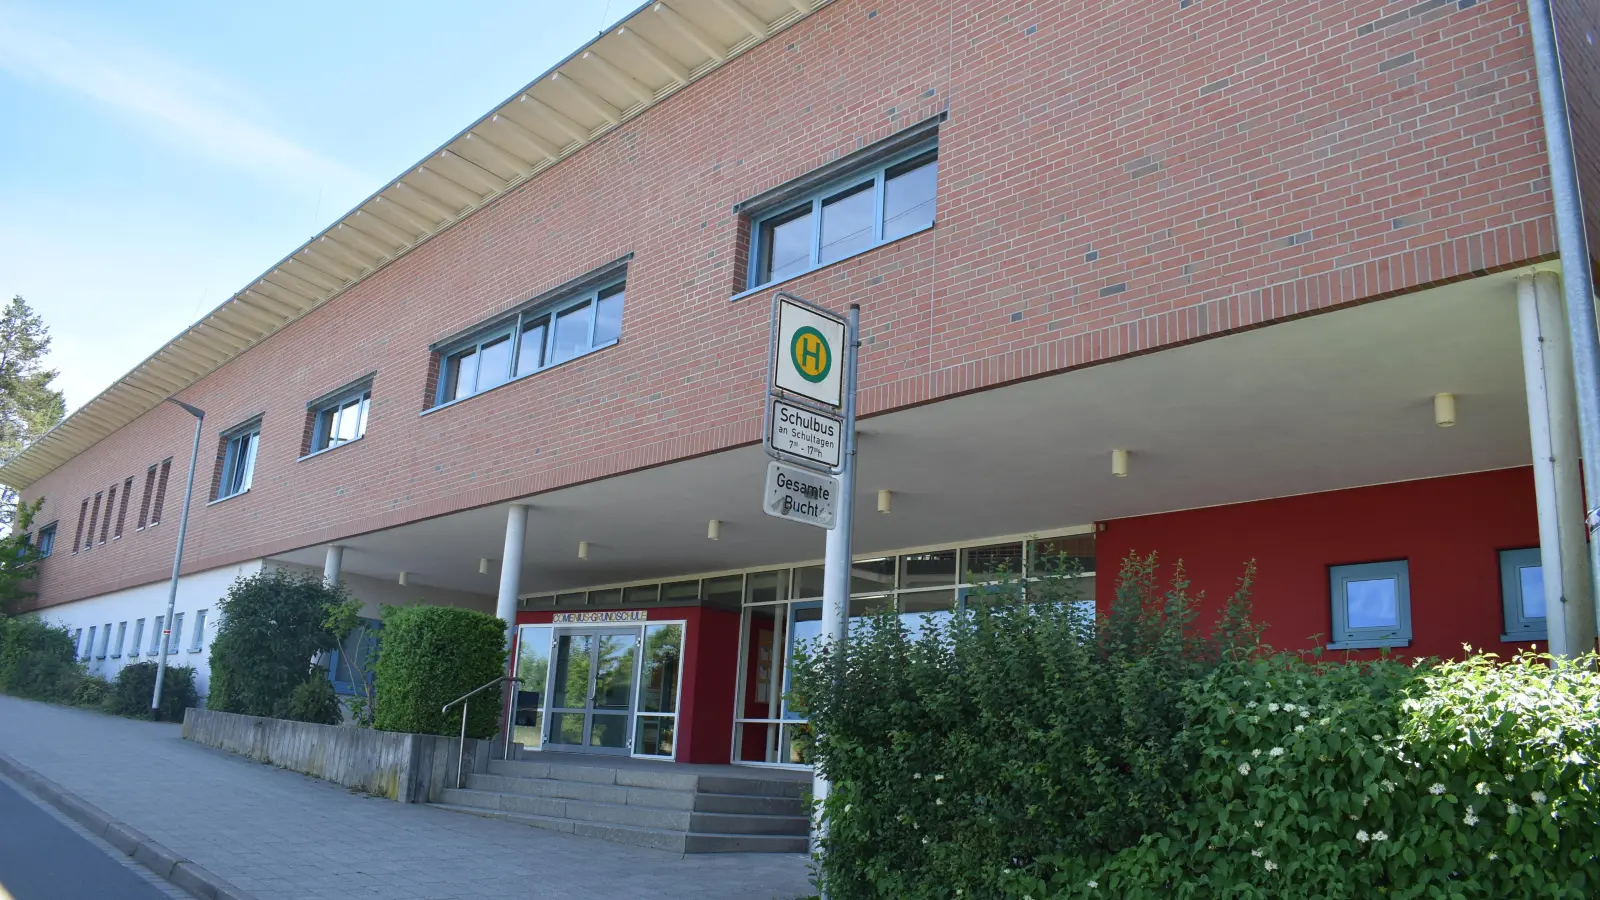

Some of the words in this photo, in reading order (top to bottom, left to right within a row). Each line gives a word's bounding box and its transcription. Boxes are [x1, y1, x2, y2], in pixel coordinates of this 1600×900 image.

[802, 337, 820, 371] H
[780, 408, 834, 436] Schulbus
[778, 426, 788, 434] an
[791, 428, 834, 448] Schultagen
[777, 473, 829, 500] Gesamte
[784, 495, 818, 517] Bucht
